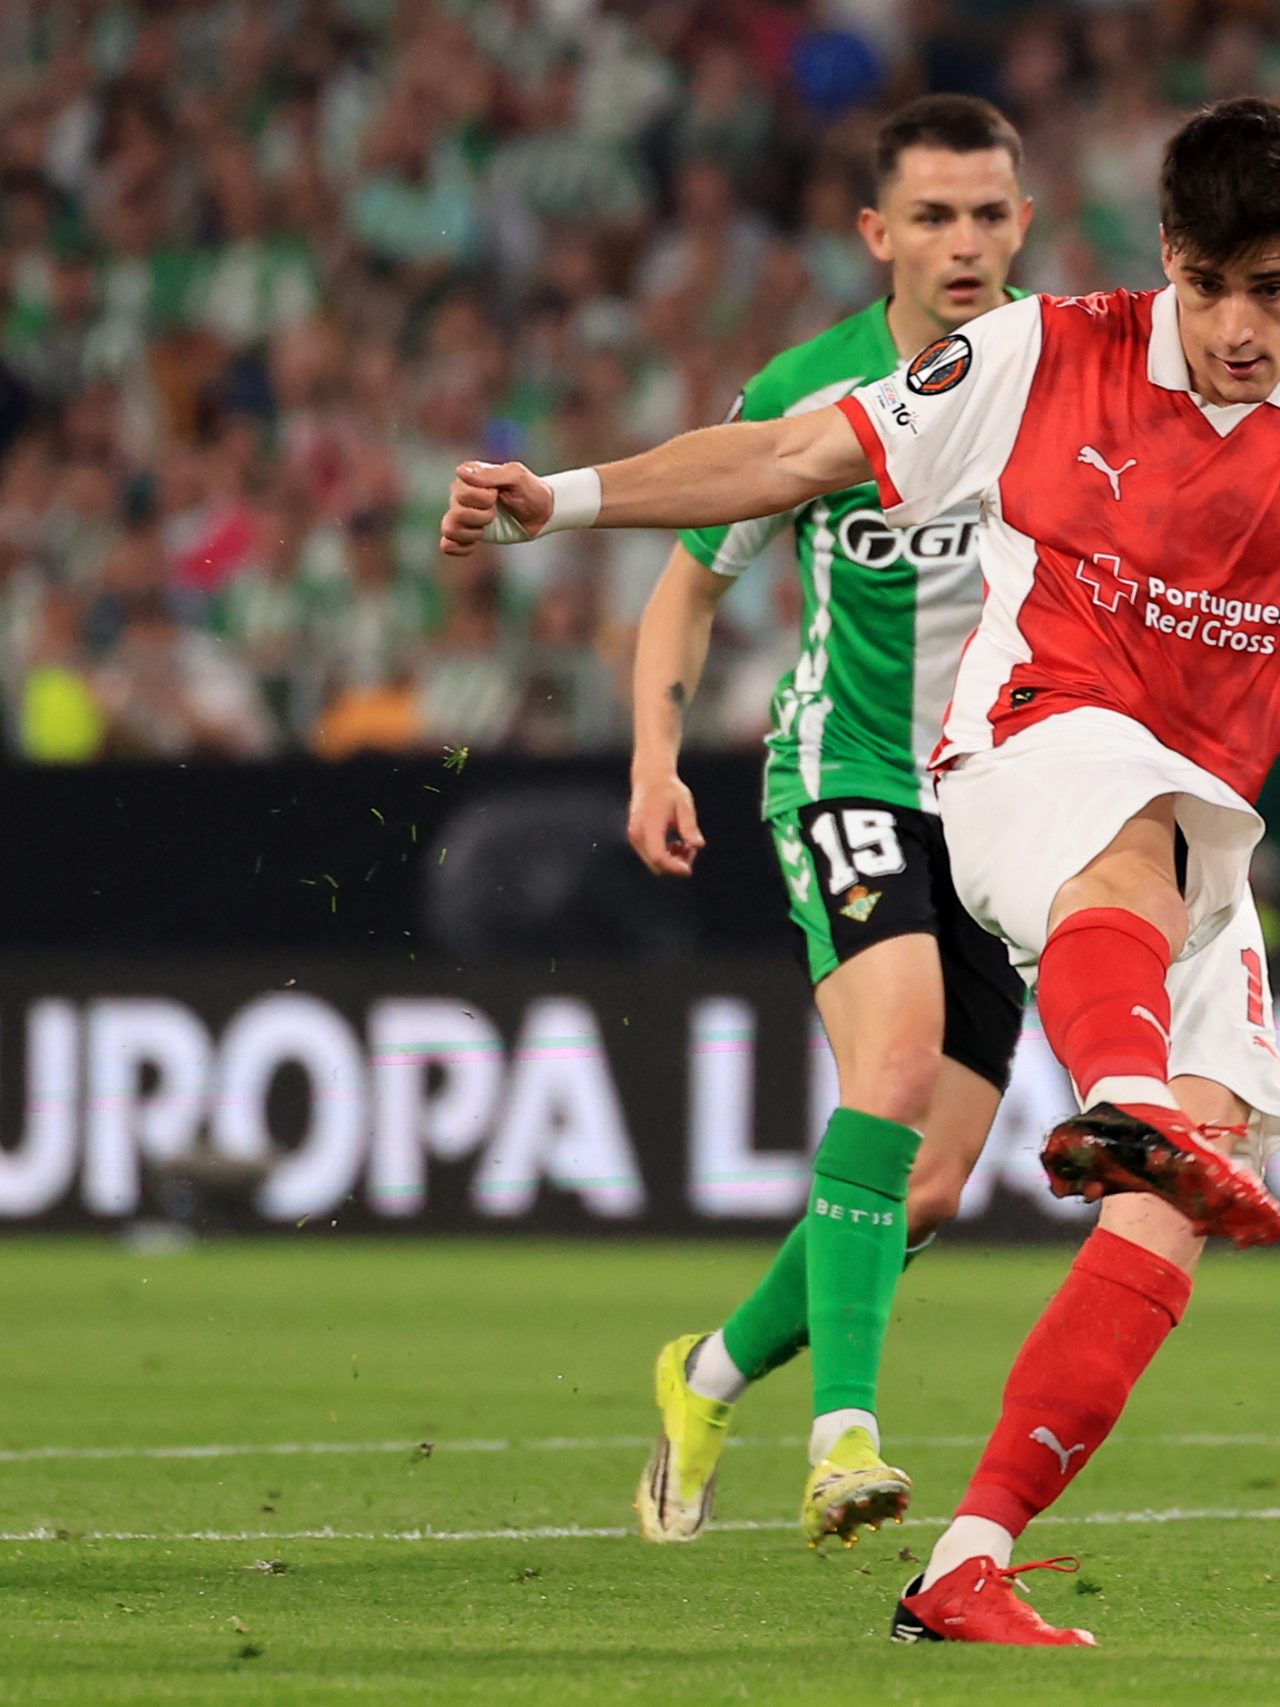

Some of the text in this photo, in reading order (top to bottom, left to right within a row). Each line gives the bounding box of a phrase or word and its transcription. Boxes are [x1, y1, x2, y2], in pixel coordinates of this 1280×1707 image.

[1145, 602, 1276, 655] Red Cross
[810, 808, 908, 896] 15
[815, 1197, 894, 1226] BETIS
